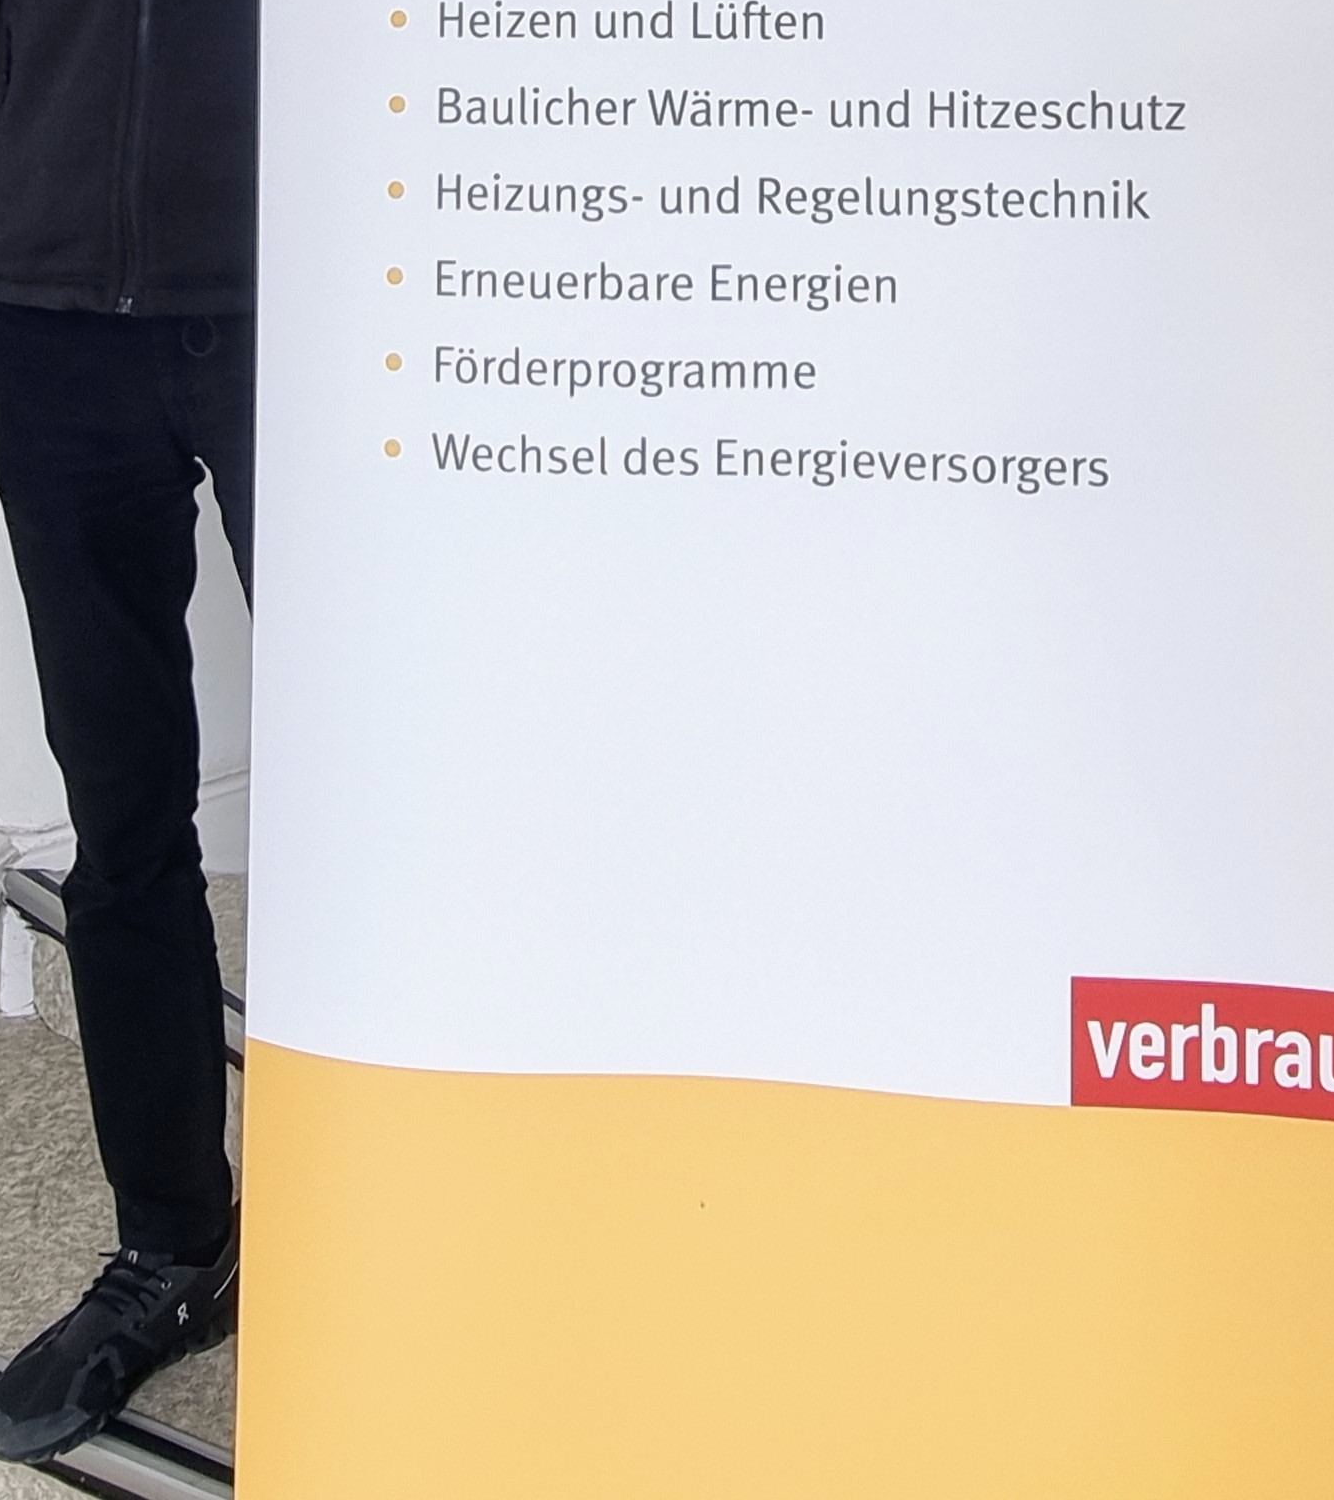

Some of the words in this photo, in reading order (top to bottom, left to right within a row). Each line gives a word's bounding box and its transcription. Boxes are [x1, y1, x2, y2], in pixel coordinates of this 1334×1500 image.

[439, 0, 576, 39] Heizen
[595, 0, 673, 39] und
[692, 0, 824, 40] Lüften
[438, 86, 637, 126] Baulicher
[647, 89, 813, 128] Wärme-
[830, 88, 910, 128] und
[929, 89, 1186, 131] Hitzeschutz
[437, 173, 643, 222] Heizungs-
[660, 175, 739, 214] und
[758, 176, 1150, 226] Regelungstechnik
[436, 260, 693, 301] Erneuerbare
[711, 264, 896, 312] Energien
[435, 346, 816, 398] Förderprogramme
[432, 432, 608, 475] Wechsel
[623, 436, 699, 476] des
[716, 439, 1109, 495] Energieversorgers
